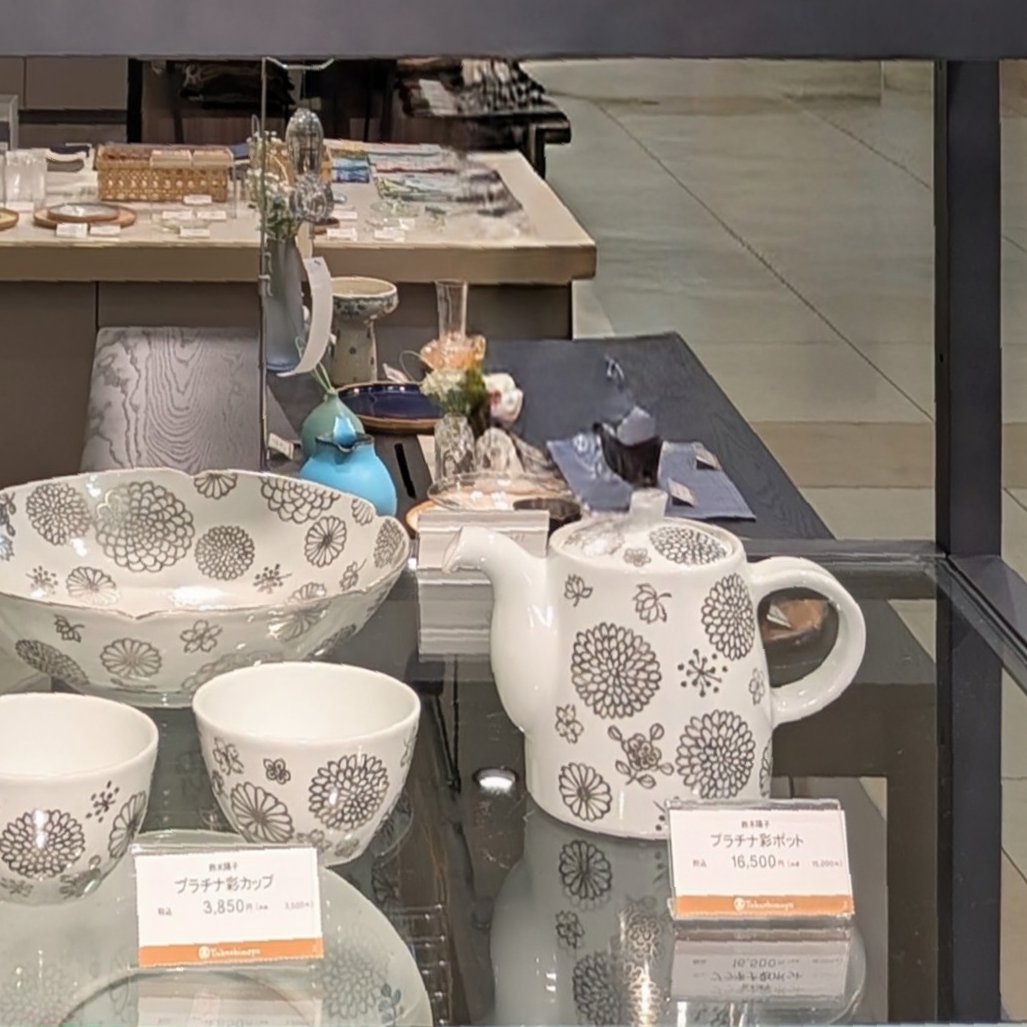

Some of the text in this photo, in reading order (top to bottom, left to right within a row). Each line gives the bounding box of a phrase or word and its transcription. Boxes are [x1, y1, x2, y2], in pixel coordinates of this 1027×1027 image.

[710, 832, 804, 848] プラチナ彩ポット
[174, 874, 274, 894] プラチナ彩カップ
